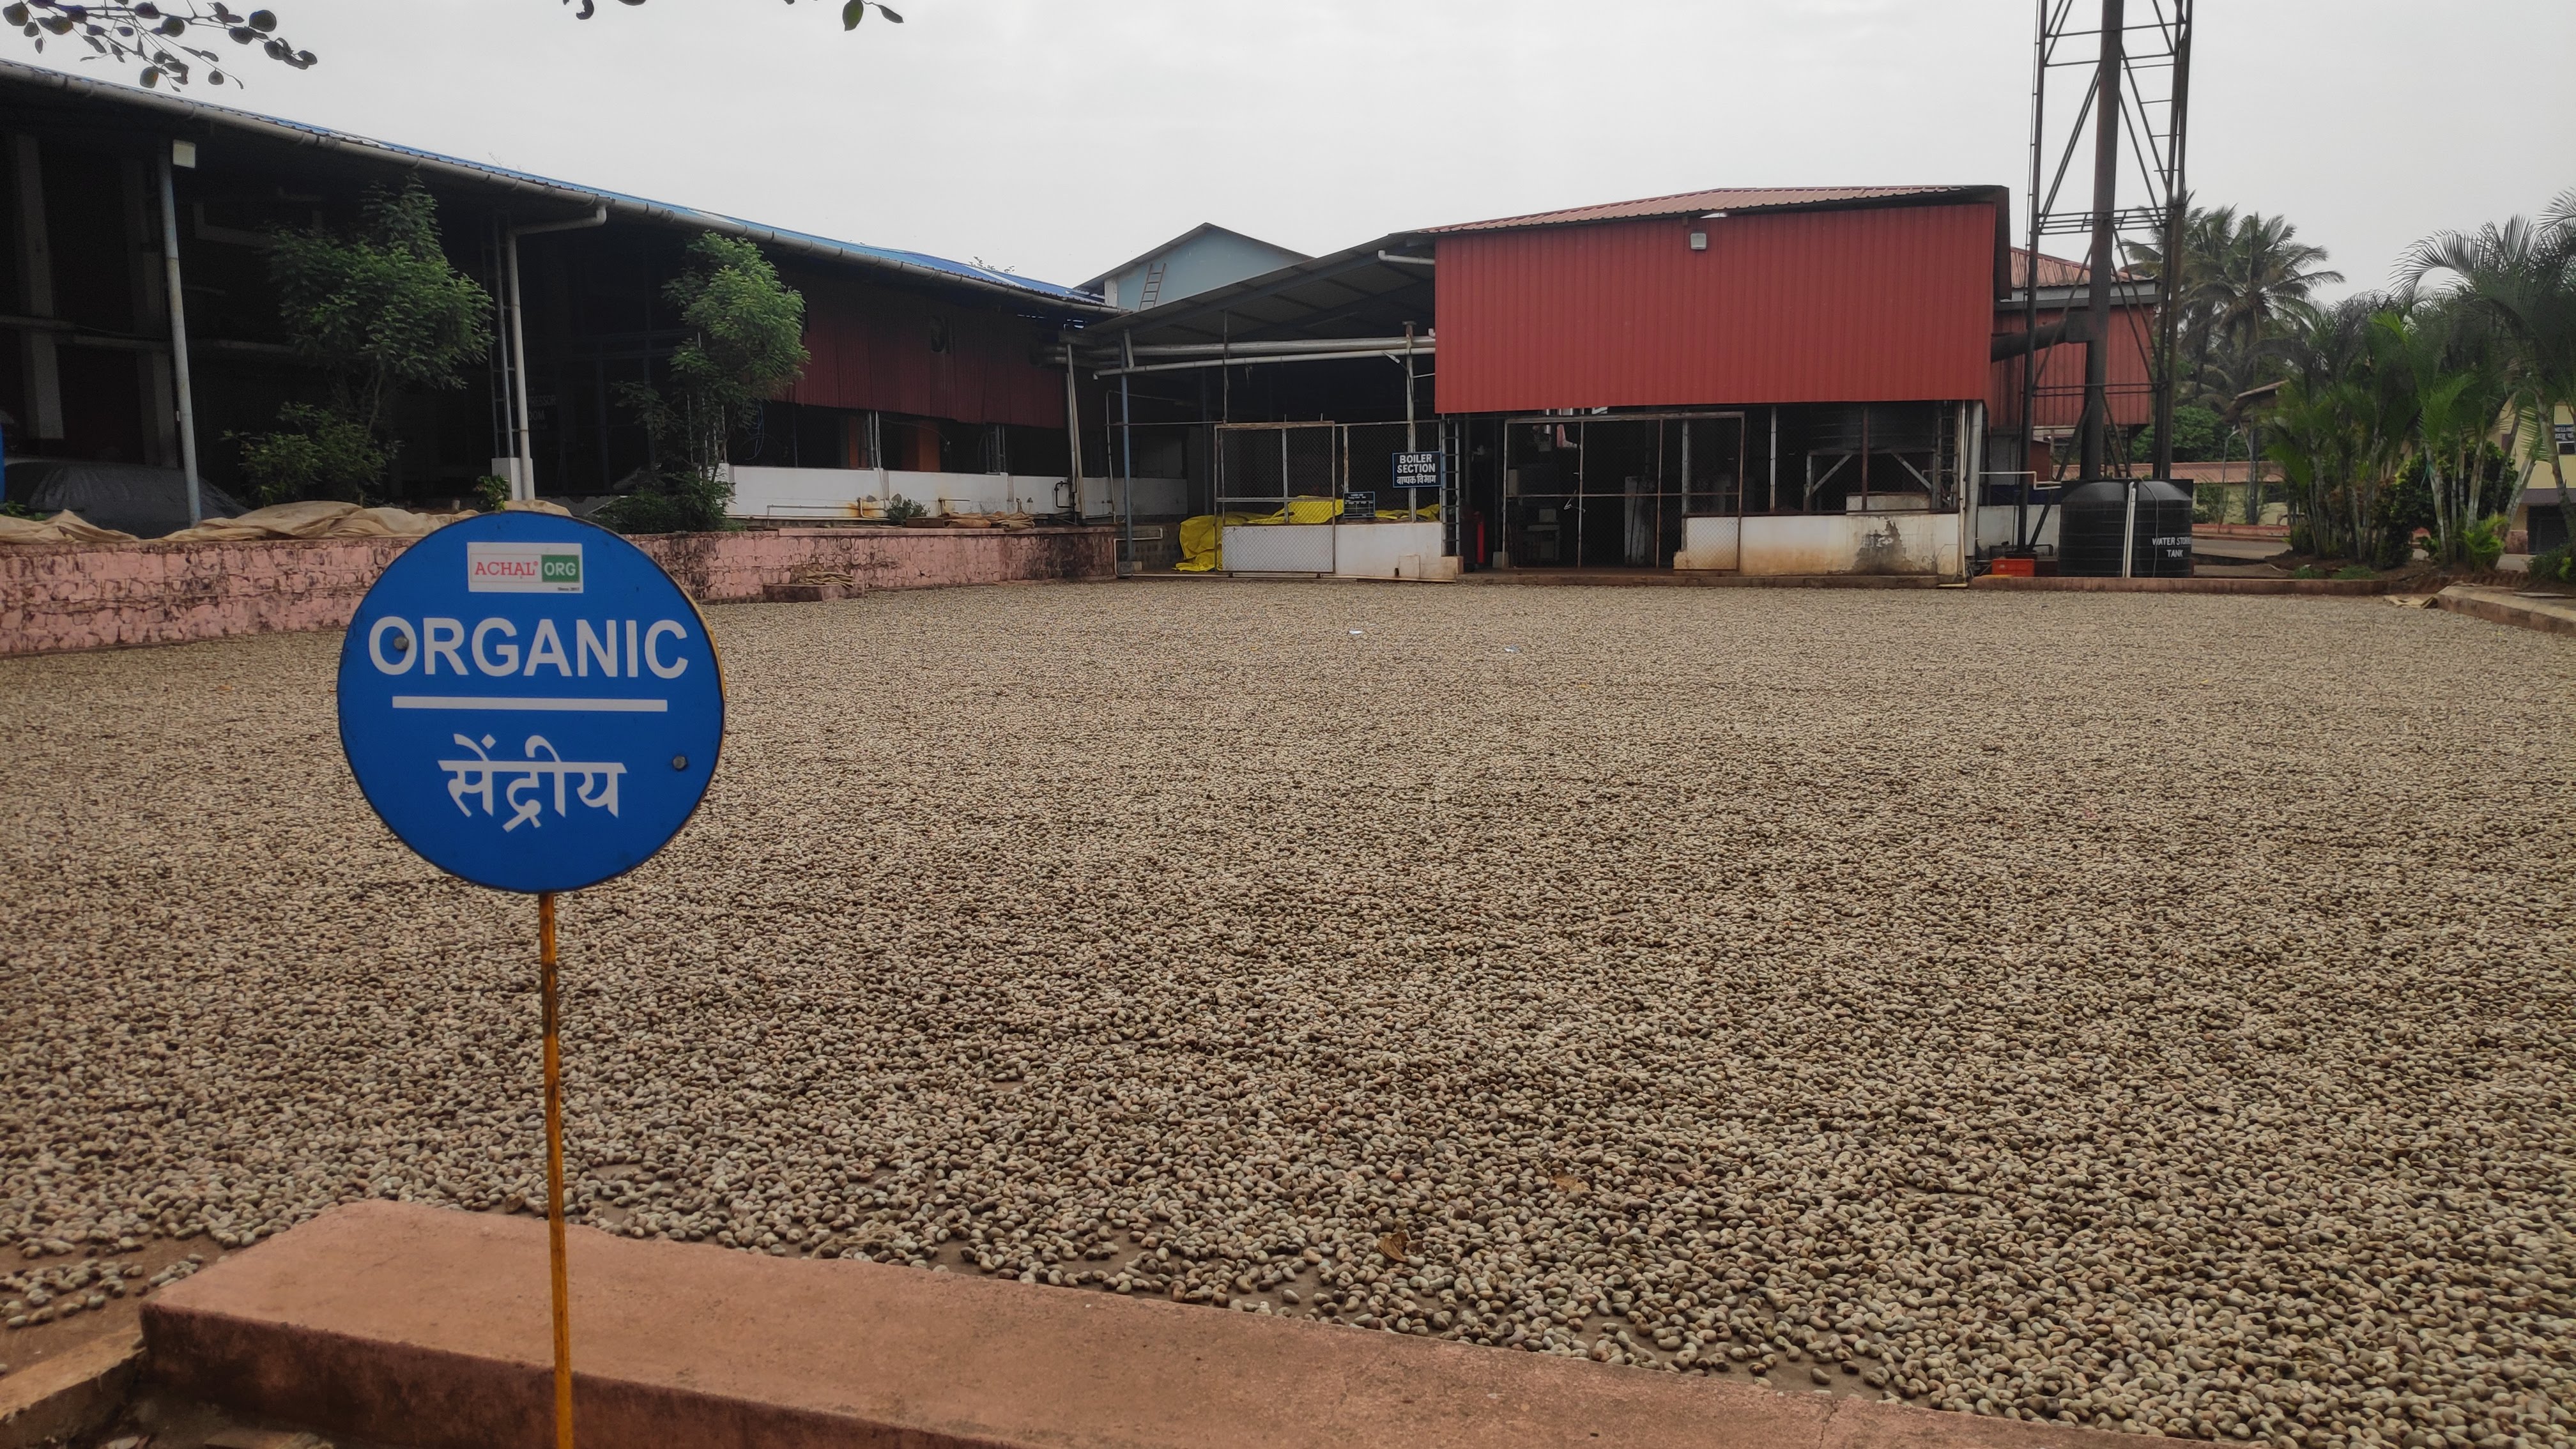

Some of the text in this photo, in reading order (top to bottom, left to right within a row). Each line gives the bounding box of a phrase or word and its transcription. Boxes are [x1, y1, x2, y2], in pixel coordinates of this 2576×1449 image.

[1399, 454, 1432, 464] BOILER
[1397, 463, 1436, 473] SECTION
[1416, 473, 1437, 484] विभाग
[2152, 537, 2175, 546] WATER
[2166, 549, 2184, 558] TANK
[544, 562, 576, 576] ORG
[368, 616, 689, 679] ORGANIC
[438, 733, 627, 833] सेंद्रीय
